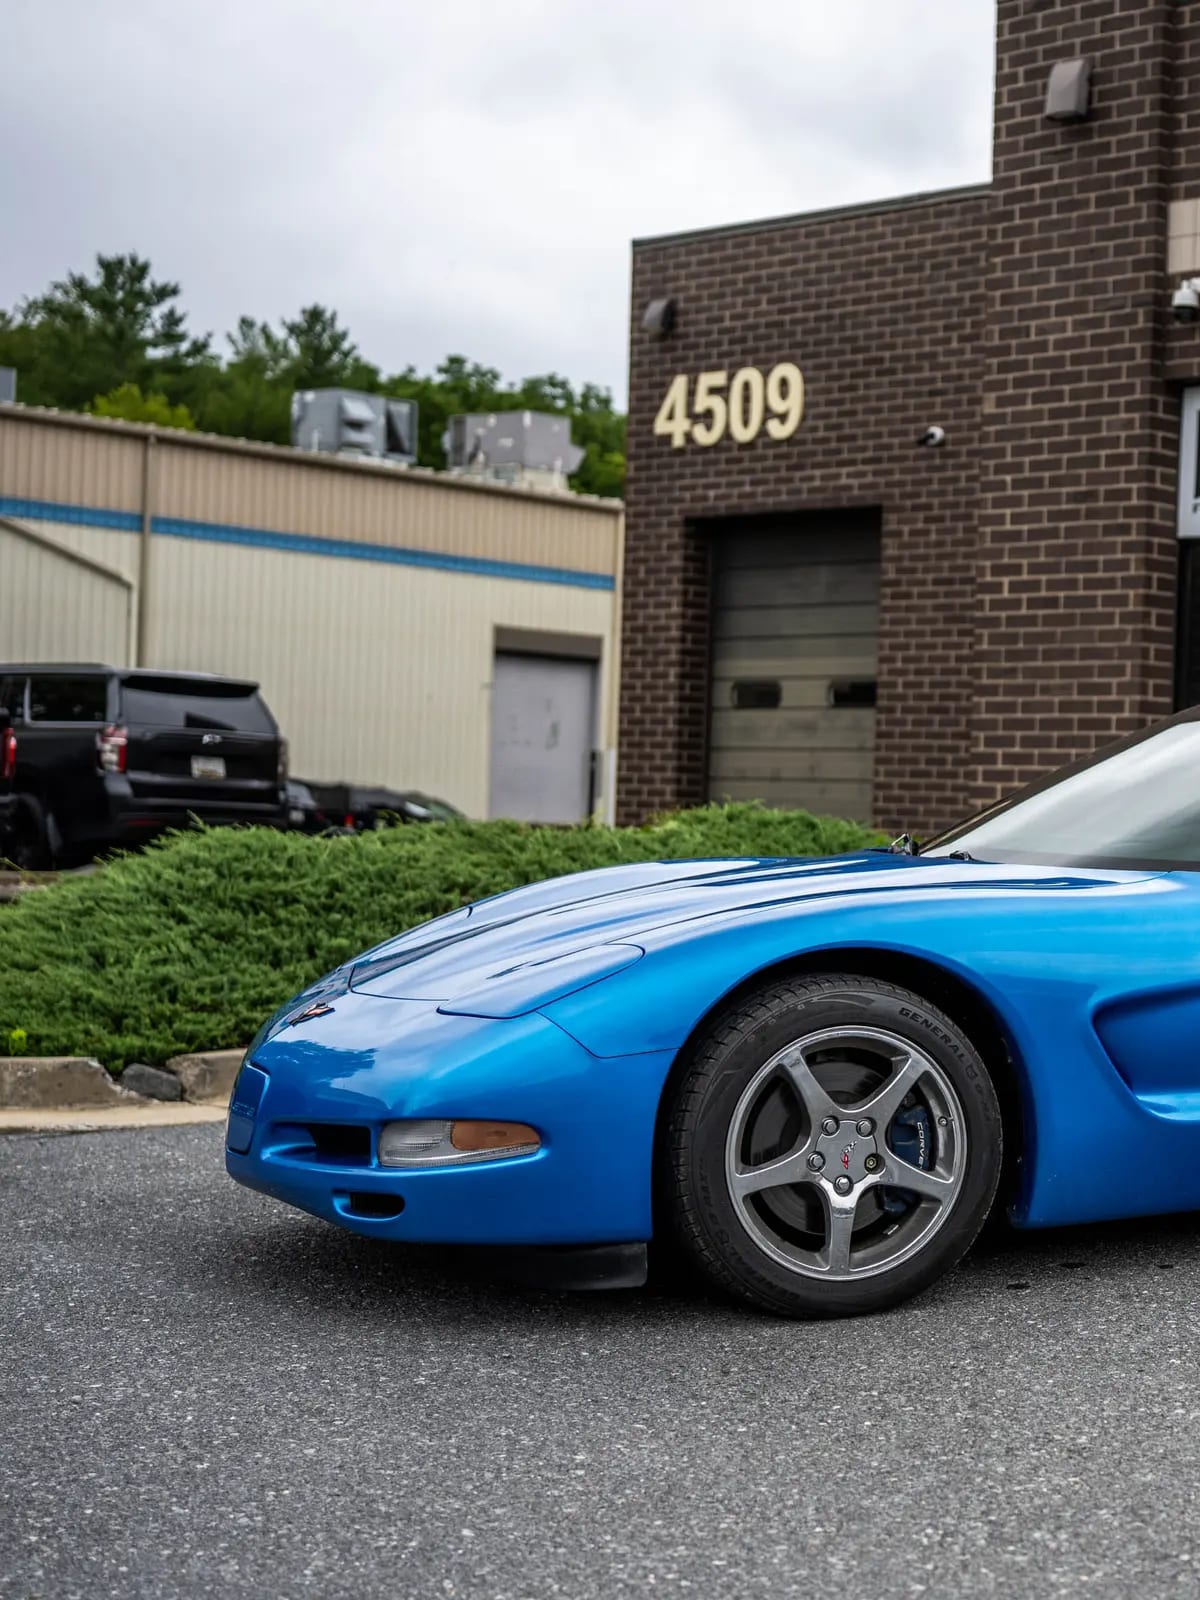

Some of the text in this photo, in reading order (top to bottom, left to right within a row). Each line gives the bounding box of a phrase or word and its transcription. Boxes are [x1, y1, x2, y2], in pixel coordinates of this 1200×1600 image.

[653, 362, 804, 448] 4509
[899, 1007, 965, 1064] GENERAL
[917, 1122, 925, 1169] CORVE
